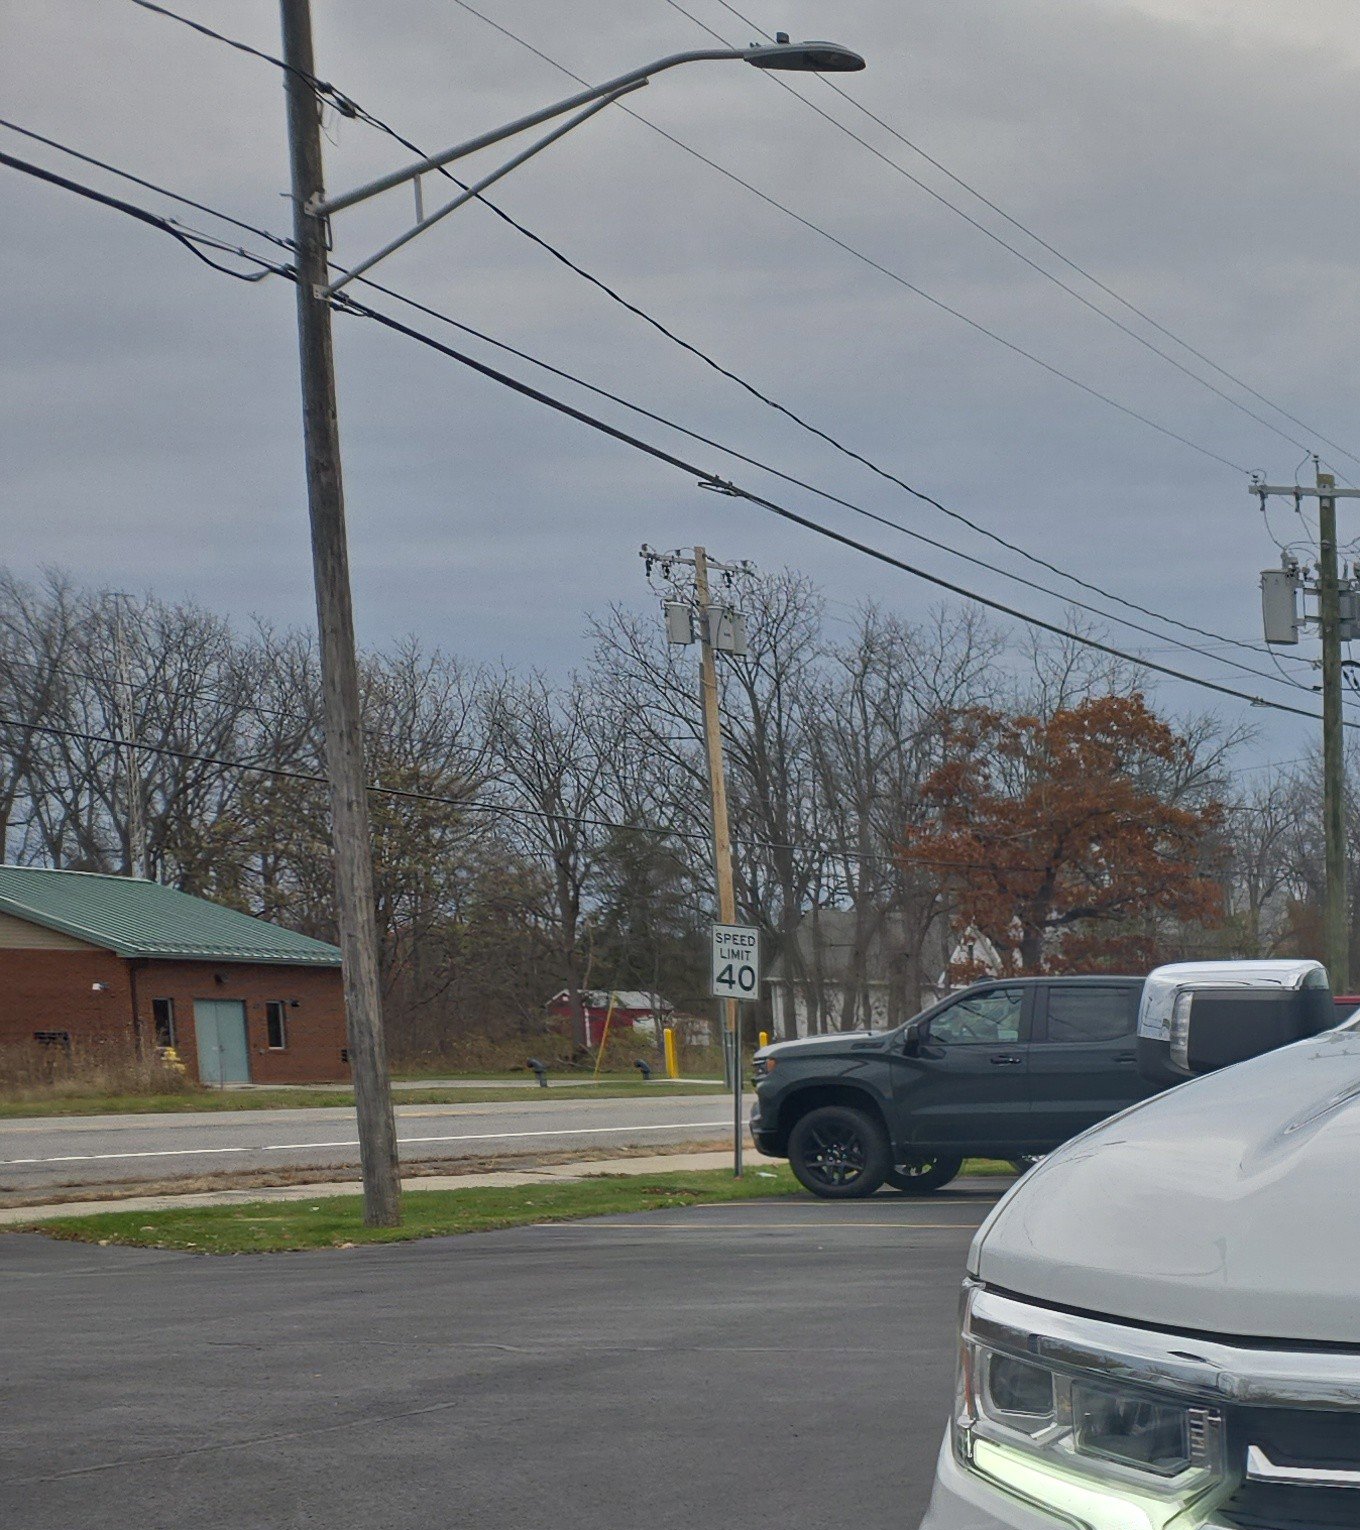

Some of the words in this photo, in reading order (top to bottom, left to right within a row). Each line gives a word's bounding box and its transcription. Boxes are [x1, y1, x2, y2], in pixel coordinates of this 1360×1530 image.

[716, 932, 756, 947] SPEED
[720, 948, 752, 961] LIMIT
[716, 963, 756, 992] 40
